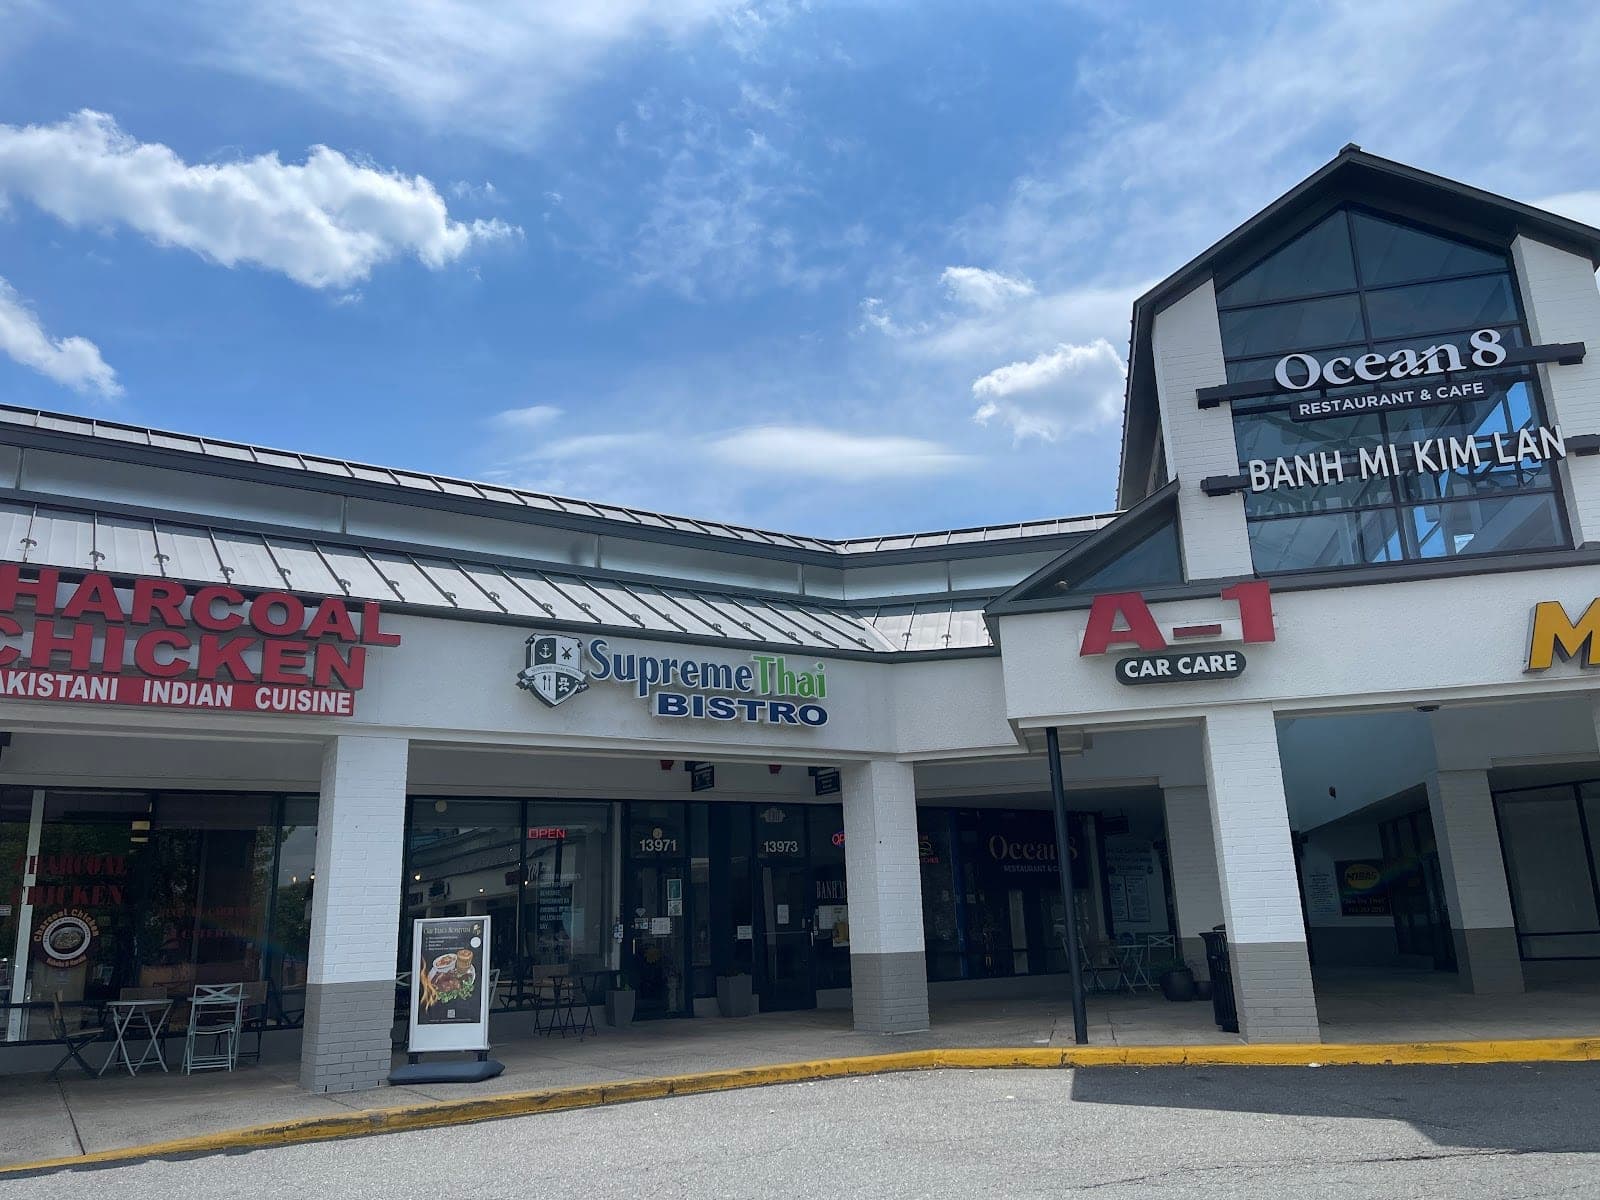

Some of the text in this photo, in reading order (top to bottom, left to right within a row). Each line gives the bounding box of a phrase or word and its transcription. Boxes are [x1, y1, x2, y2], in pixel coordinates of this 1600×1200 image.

[1274, 328, 1507, 391] Ocean 8
[1299, 381, 1485, 416] RESTAURANT & CAFE
[1248, 424, 1567, 492] BANH MI KIM LAN
[1080, 580, 1276, 657] A-1
[588, 639, 827, 700] Supreme Thai
[1124, 653, 1238, 678] CAR CARE
[143, 680, 233, 707] INDIAN
[255, 687, 351, 714] CUISINE
[656, 693, 829, 727] BISTRO
[528, 828, 567, 839] OPEN
[639, 839, 677, 852] 13971
[763, 840, 799, 853] 13973
